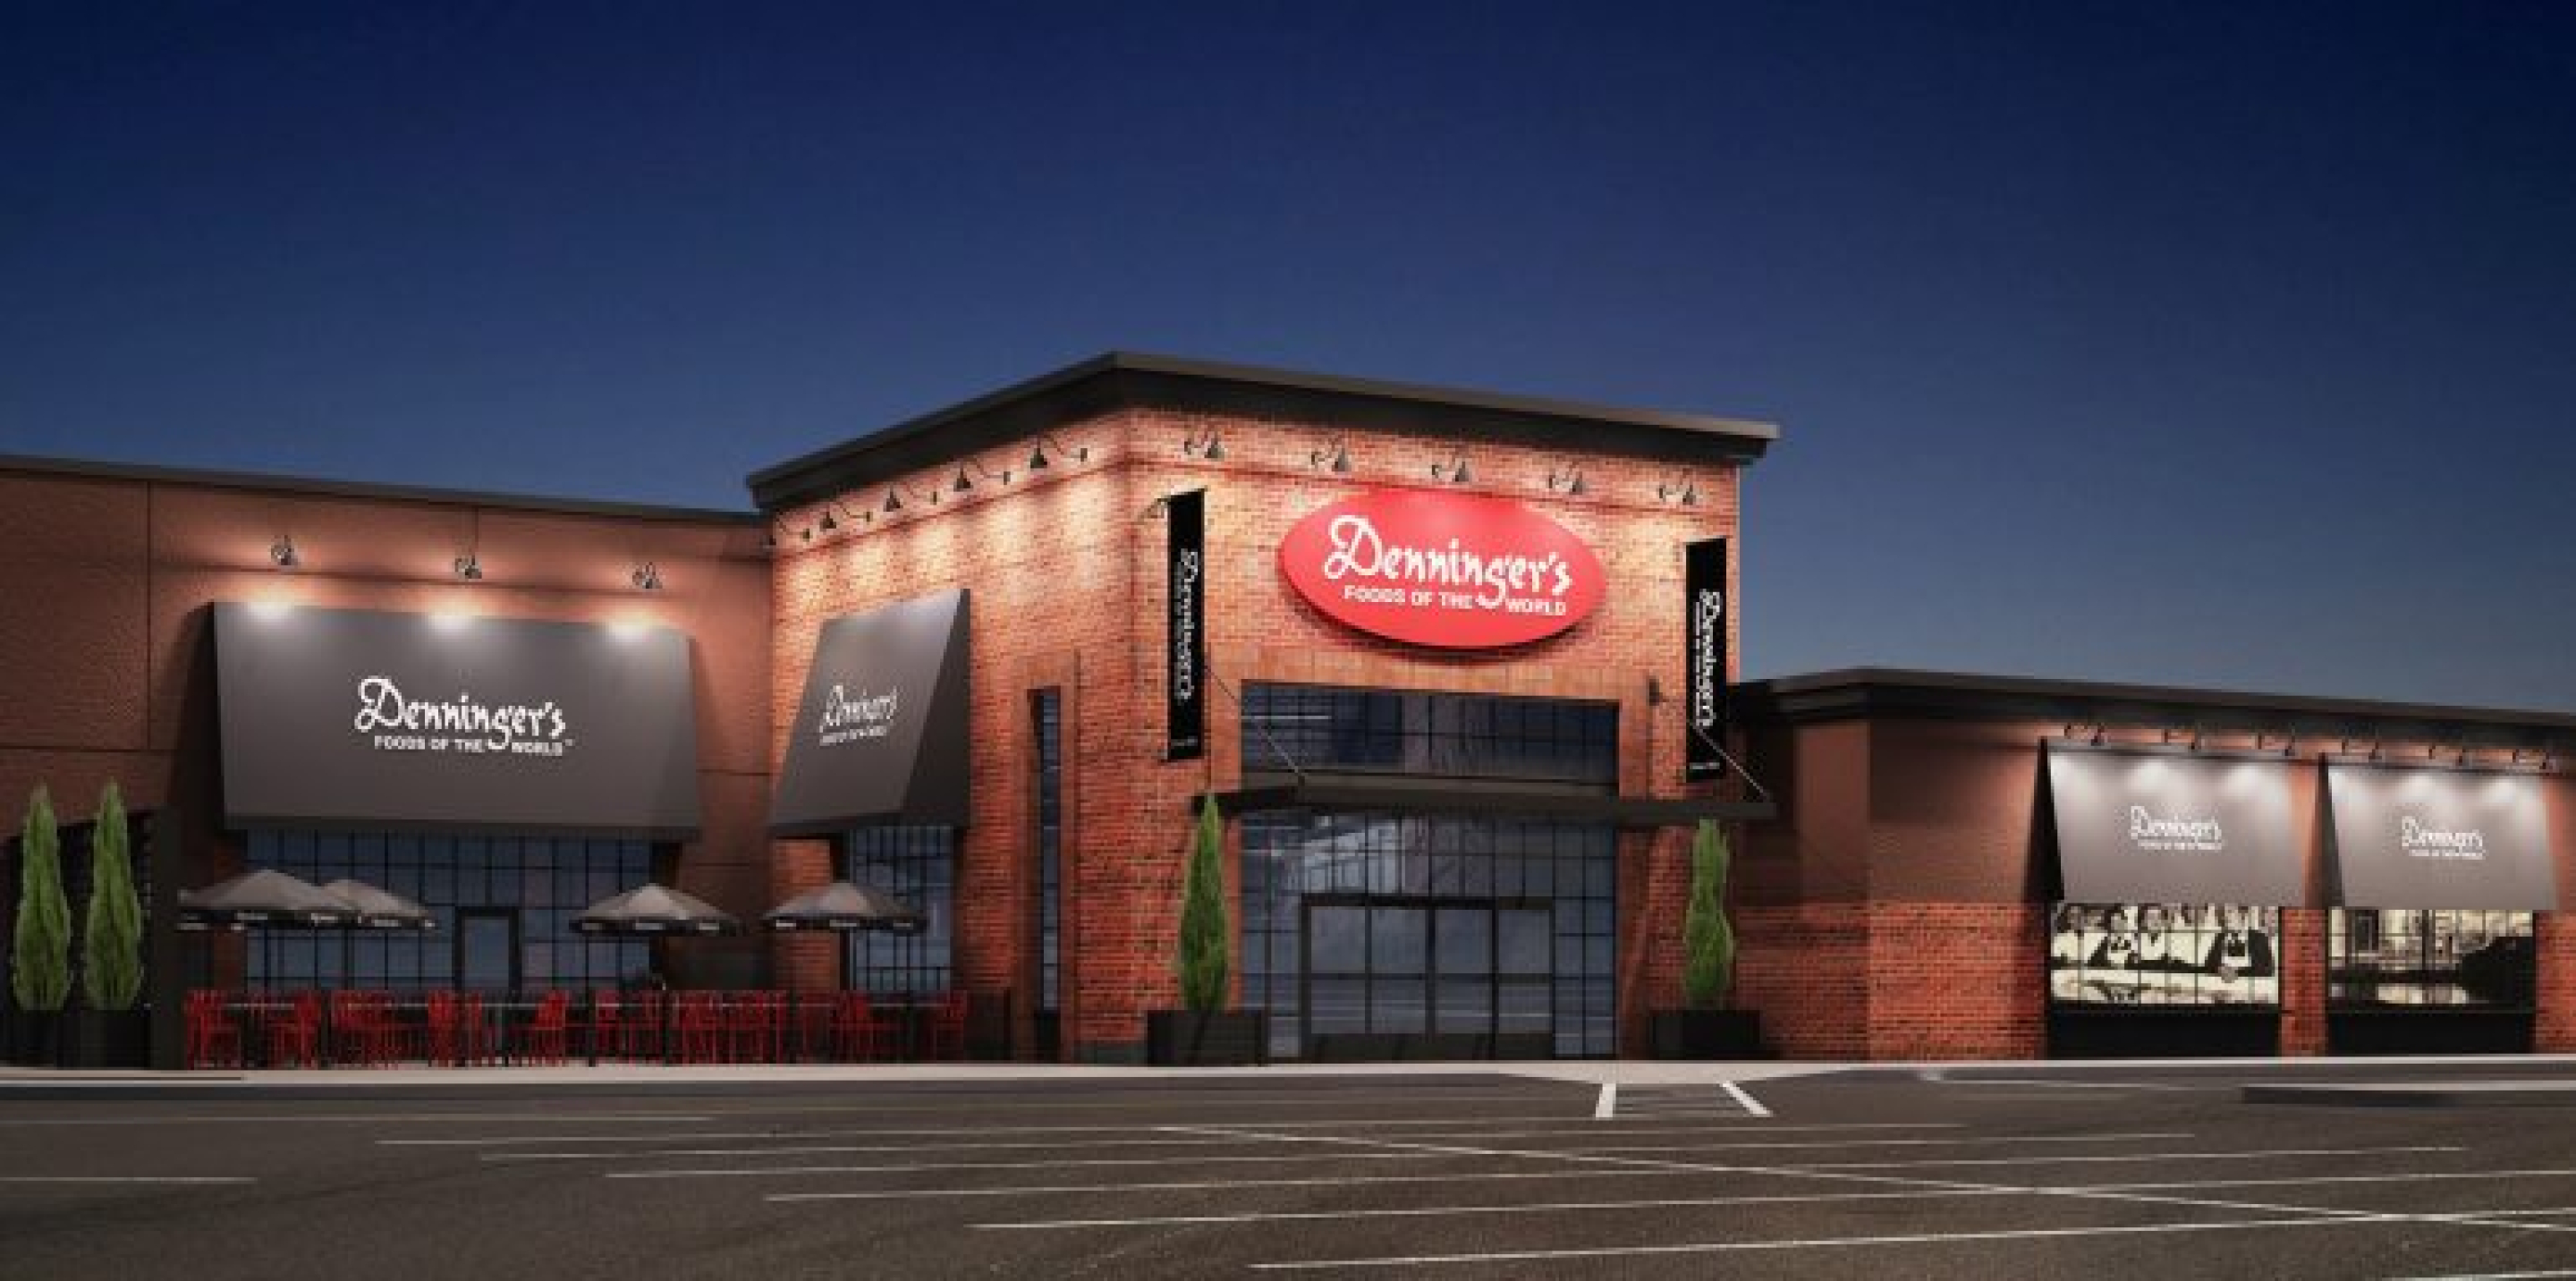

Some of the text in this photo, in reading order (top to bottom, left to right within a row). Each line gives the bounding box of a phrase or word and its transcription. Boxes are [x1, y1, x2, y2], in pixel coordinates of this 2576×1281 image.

[1325, 515, 1572, 608] Denninger's
[1344, 585, 1566, 615] FOODS OF THE WORLD
[355, 676, 566, 750] Denninger's
[375, 735, 425, 750] FOODS
[431, 738, 448, 750] OF
[454, 739, 485, 753] THE
